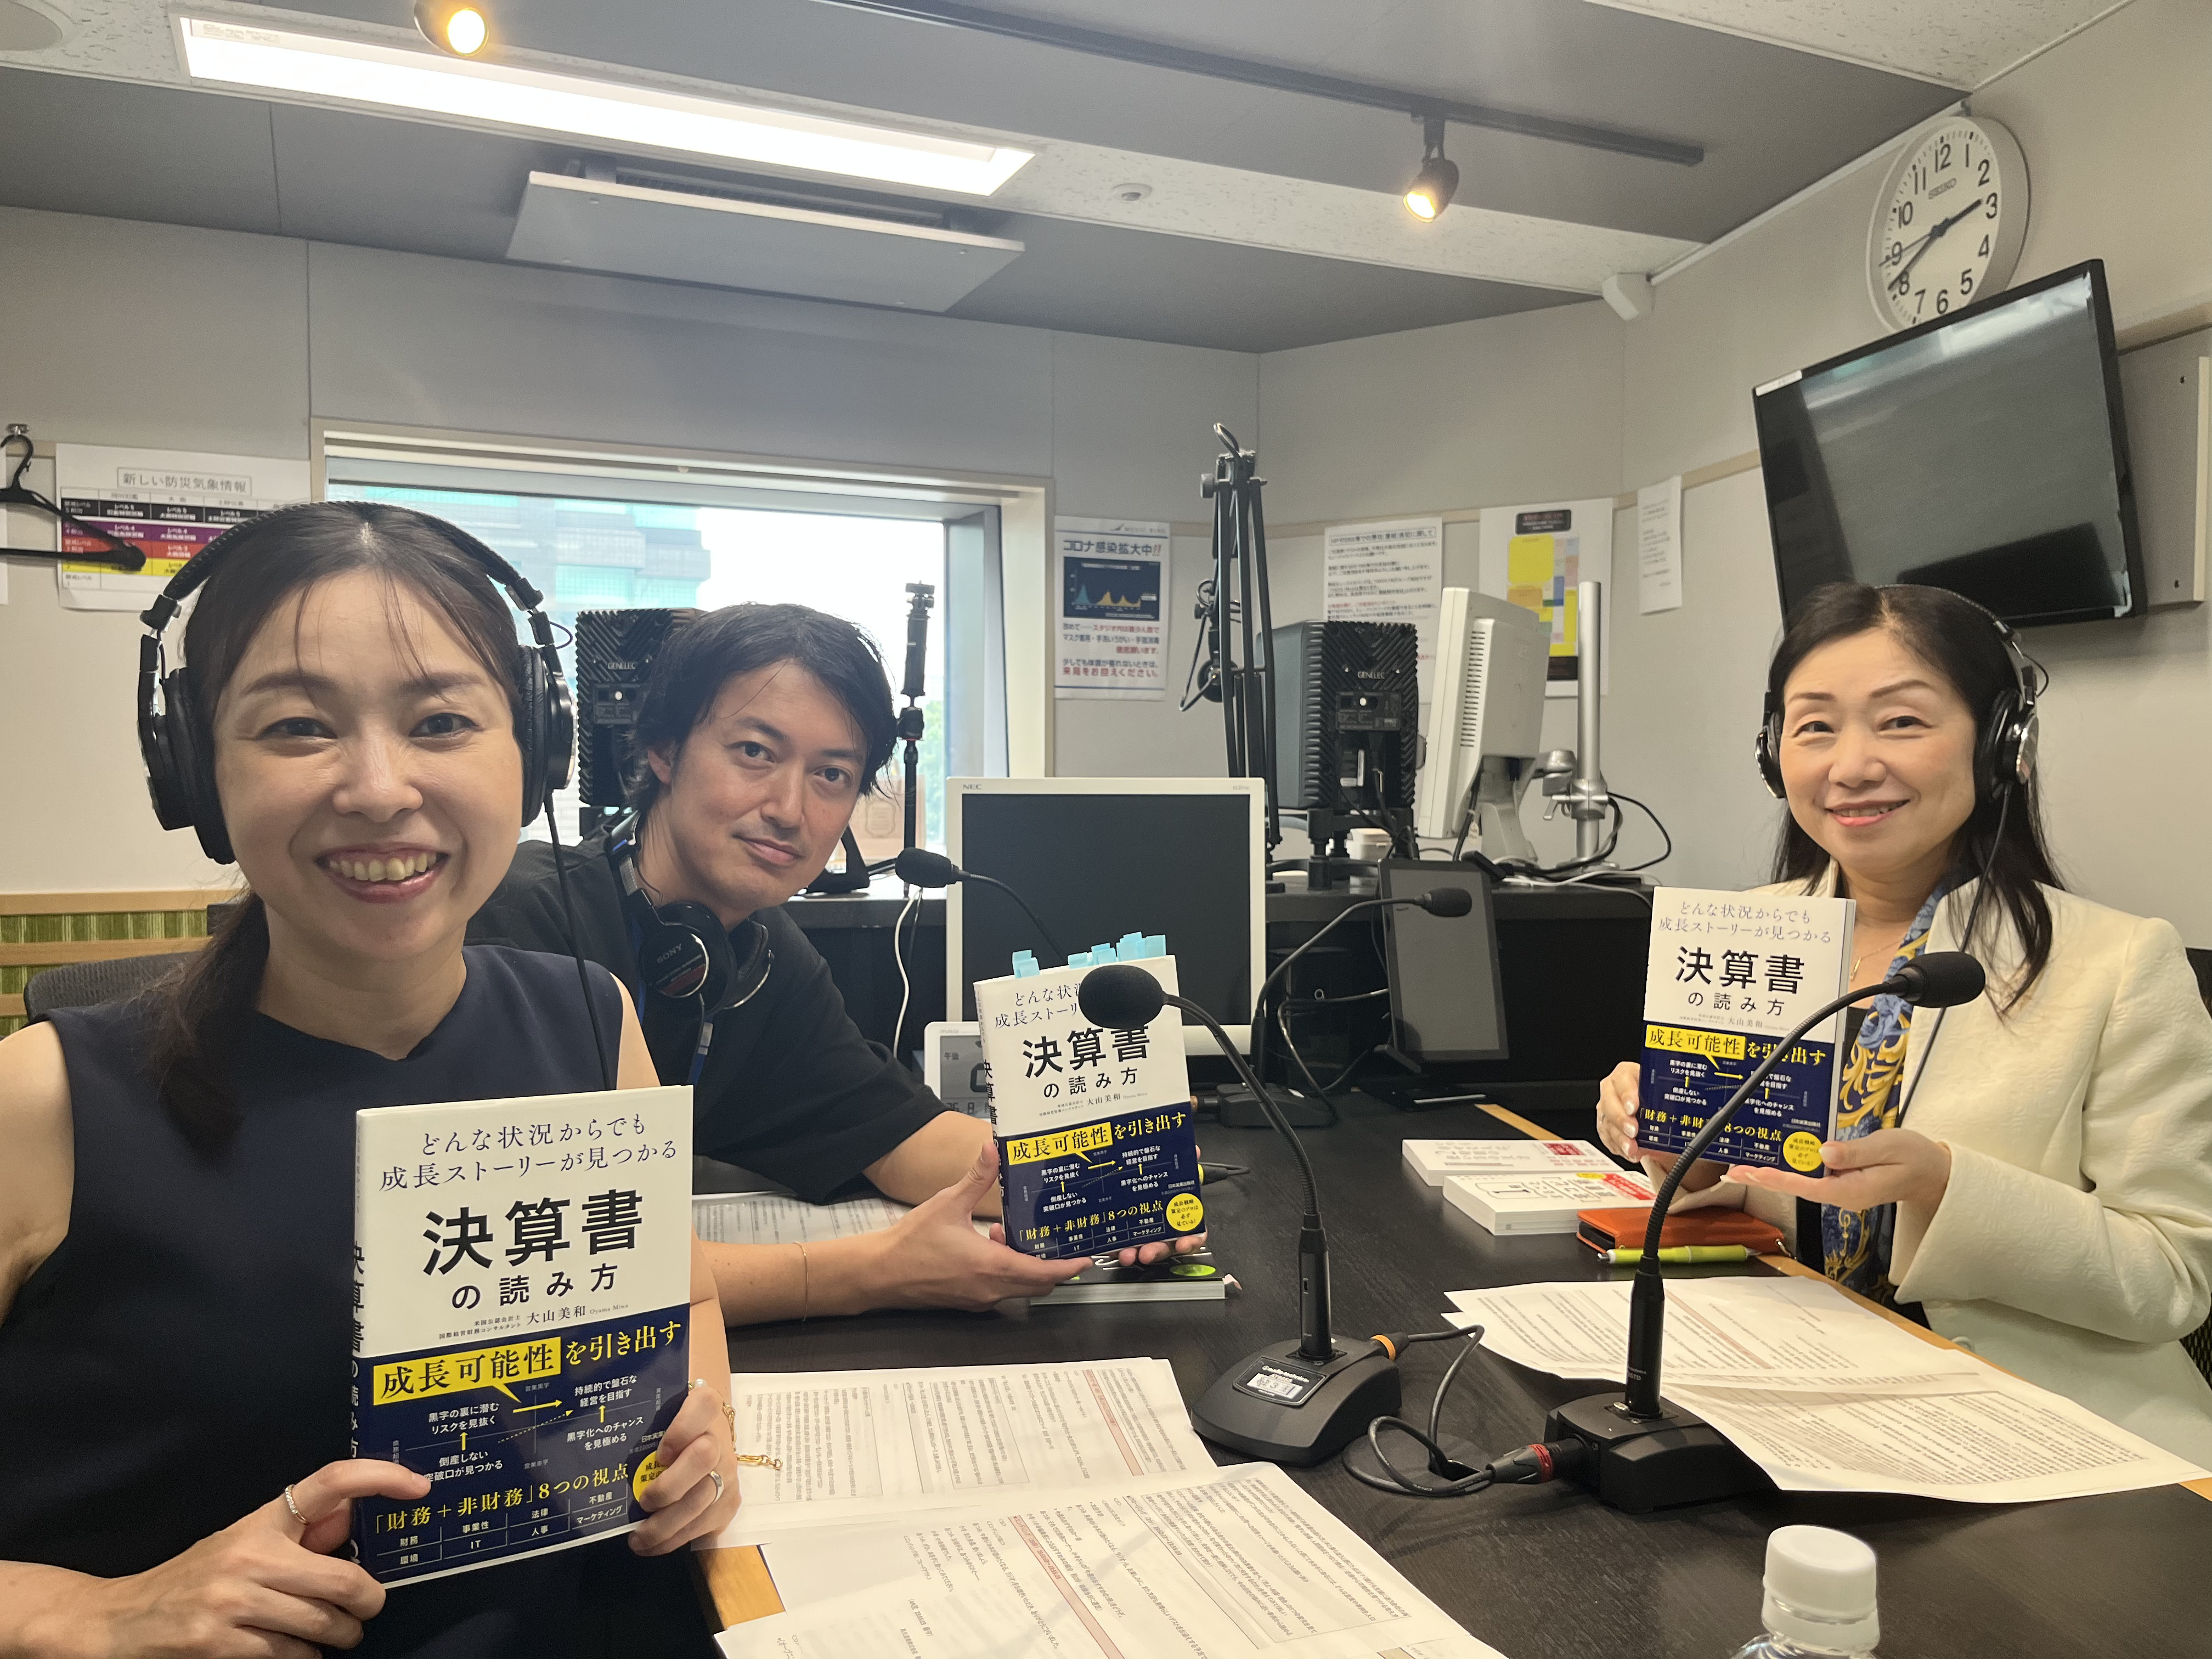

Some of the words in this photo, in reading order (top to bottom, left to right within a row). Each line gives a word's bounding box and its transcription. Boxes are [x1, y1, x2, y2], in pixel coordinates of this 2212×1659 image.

[1935, 143, 1951, 173] 12
[1965, 144, 1970, 167] 1
[1914, 166, 1927, 195] 11
[1978, 159, 1990, 187] 2
[1898, 201, 1914, 229] 10
[1985, 192, 1997, 219] 3
[1891, 241, 1902, 266] 9
[1978, 234, 1989, 258] 4
[1898, 270, 1910, 296] 8
[1960, 268, 1973, 295] 5
[1915, 289, 1926, 314] 7
[1936, 289, 1949, 314] 6
[1357, 670, 1385, 680] GENELEC
[1680, 901, 1810, 924] どんな状況からでも
[1658, 917, 1831, 944] 成長ストーリーが見つかる
[656, 943, 682, 964] SONY
[1675, 945, 1805, 995] 決算書
[1688, 991, 1785, 1017] の読み方
[1022, 1026, 1150, 1078] 決算書
[1649, 1028, 1741, 1056] 成長可能性
[1043, 1067, 1137, 1098] の読み方
[1087, 1093, 1120, 1106] 大山美和
[422, 1114, 645, 1155] どんな状況からでも
[1012, 1127, 1109, 1161] 成長可能性
[1114, 1111, 1186, 1139] を引き出す
[379, 1141, 676, 1192] 成長ストーリーが見つかる
[1043, 1171, 1080, 1183] リスクを見抜く
[422, 1189, 643, 1276] 決算書
[452, 1263, 618, 1310] の読み方
[527, 1305, 586, 1325] 大山美和
[590, 1307, 611, 1315] Oyama
[380, 1344, 555, 1399] 成長可能性
[566, 1321, 681, 1365] を引き出す
[574, 1374, 637, 1396] 持続的で盤石な
[580, 1388, 632, 1407] 経営を目指す
[428, 1402, 499, 1423] 黒字の裏に潜む
[432, 1415, 495, 1435] リスクを見抜く
[567, 1417, 644, 1442] 黒字化へのチャンス
[584, 1432, 627, 1451] を見極める
[439, 1452, 488, 1467] 倒産しない
[589, 1492, 613, 1504] 不動産
[532, 1508, 548, 1519] 法律
[577, 1505, 623, 1523] マーケティング
[462, 1521, 489, 1533] 事業性
[532, 1526, 548, 1536] 人事
[400, 1536, 418, 1547] 財務
[470, 1540, 482, 1549] IT
